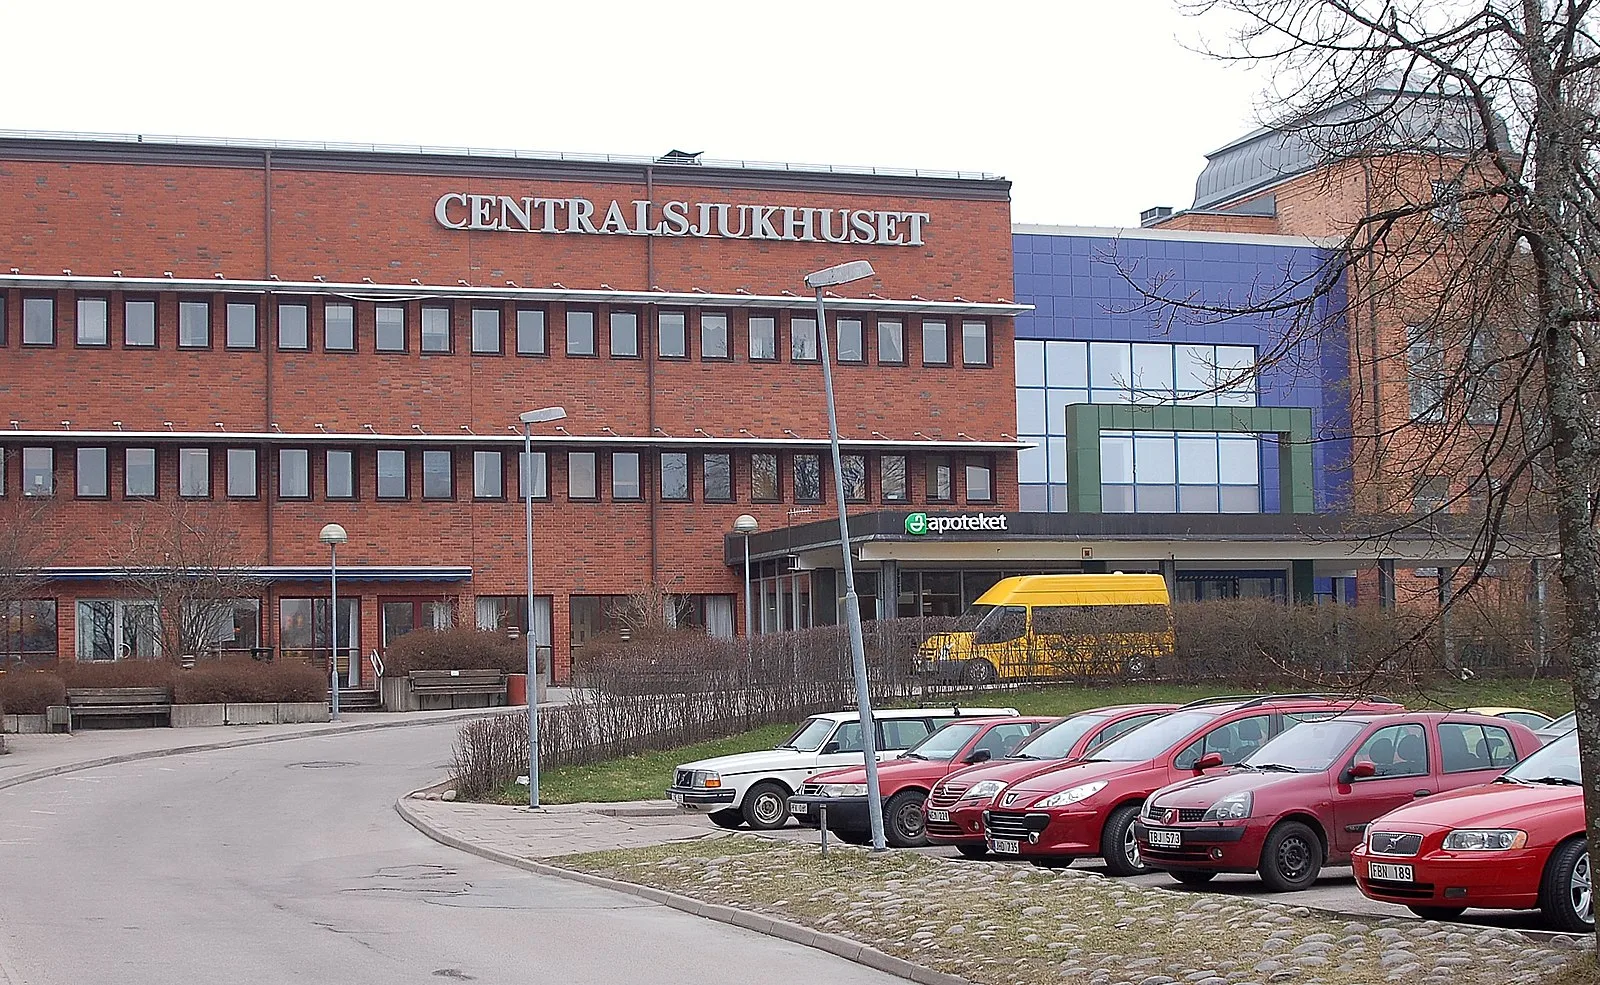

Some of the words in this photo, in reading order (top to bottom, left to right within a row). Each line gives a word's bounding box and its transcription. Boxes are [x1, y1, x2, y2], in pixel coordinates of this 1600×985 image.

[434, 192, 930, 247] CENTRALSJUKHUSET
[928, 512, 1008, 534] apoteket
[1150, 832, 1162, 843] TBJ
[1165, 832, 1180, 844] 573
[1373, 864, 1388, 878] FBN
[1394, 866, 1411, 880] 189
